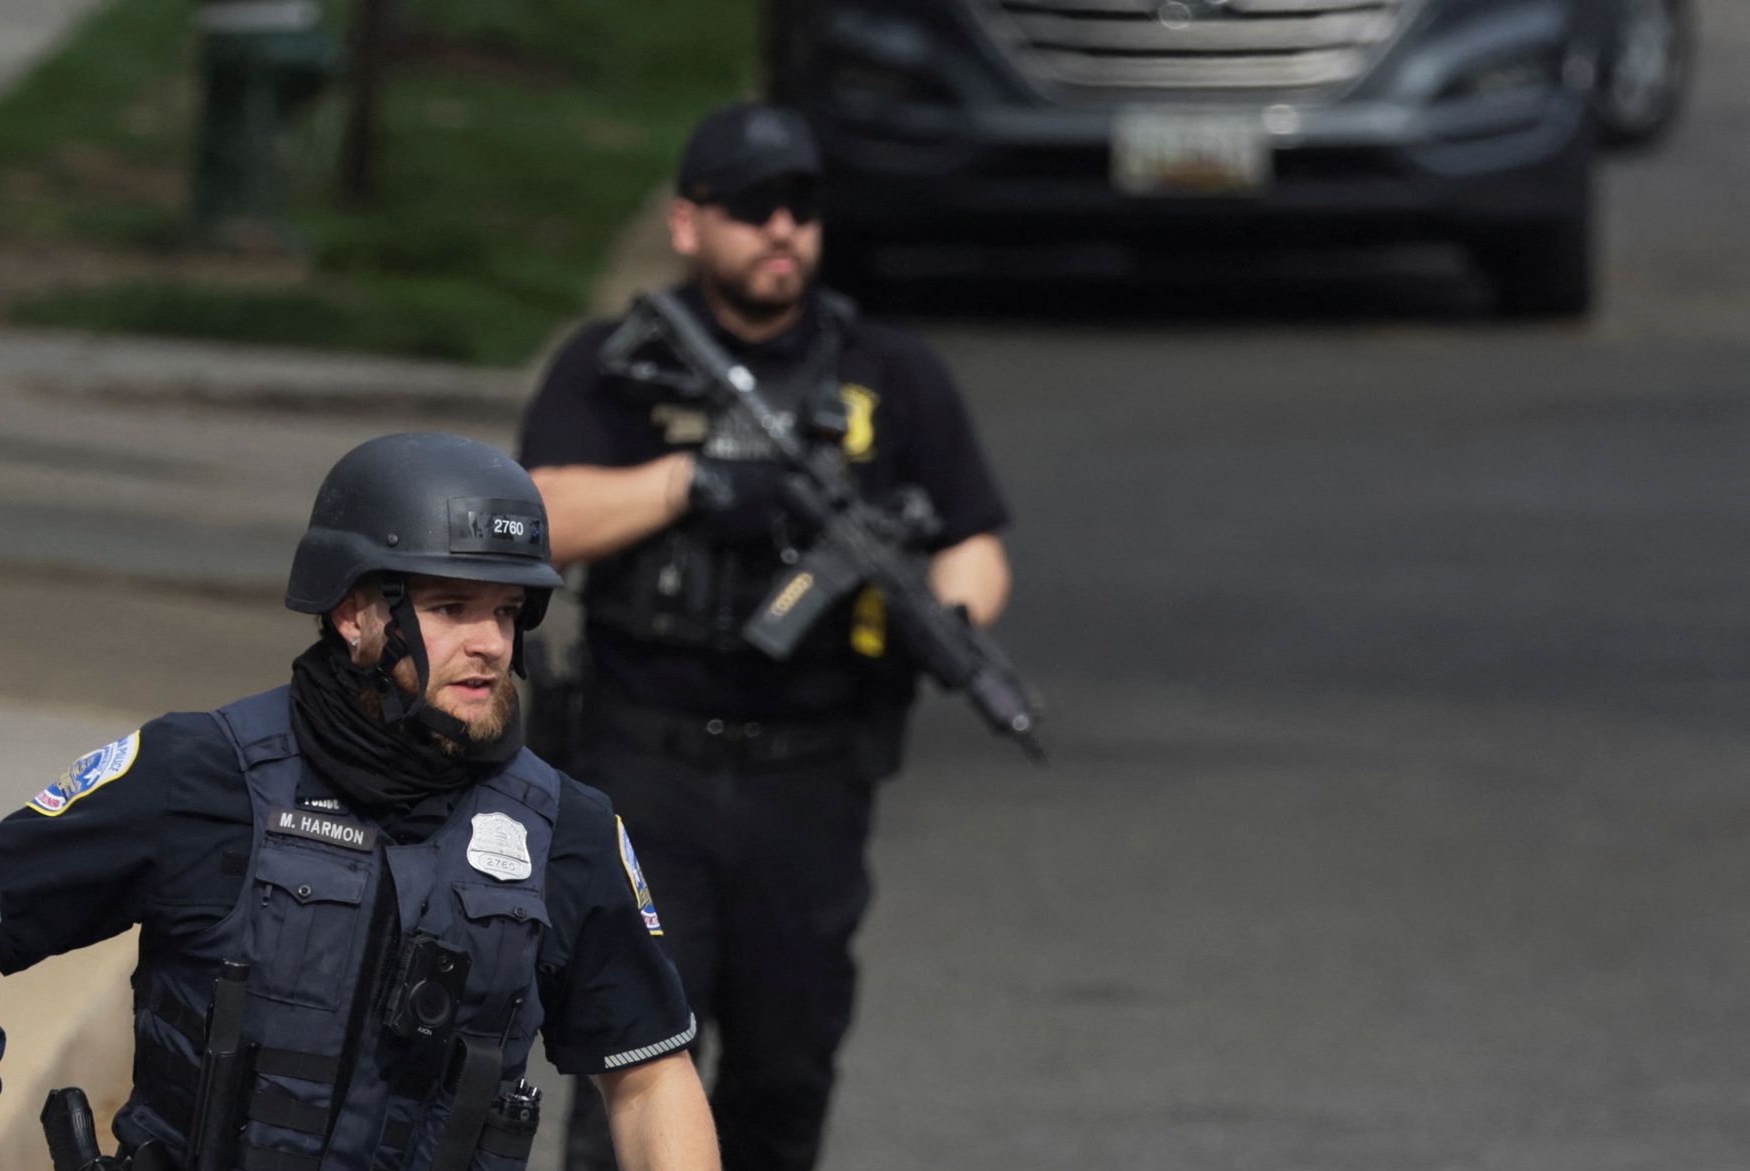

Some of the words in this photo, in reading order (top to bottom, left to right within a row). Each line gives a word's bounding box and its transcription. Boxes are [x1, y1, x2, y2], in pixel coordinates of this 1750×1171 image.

[494, 519, 524, 535] 2760
[279, 812, 296, 829] M.
[300, 816, 365, 846] HARMON
